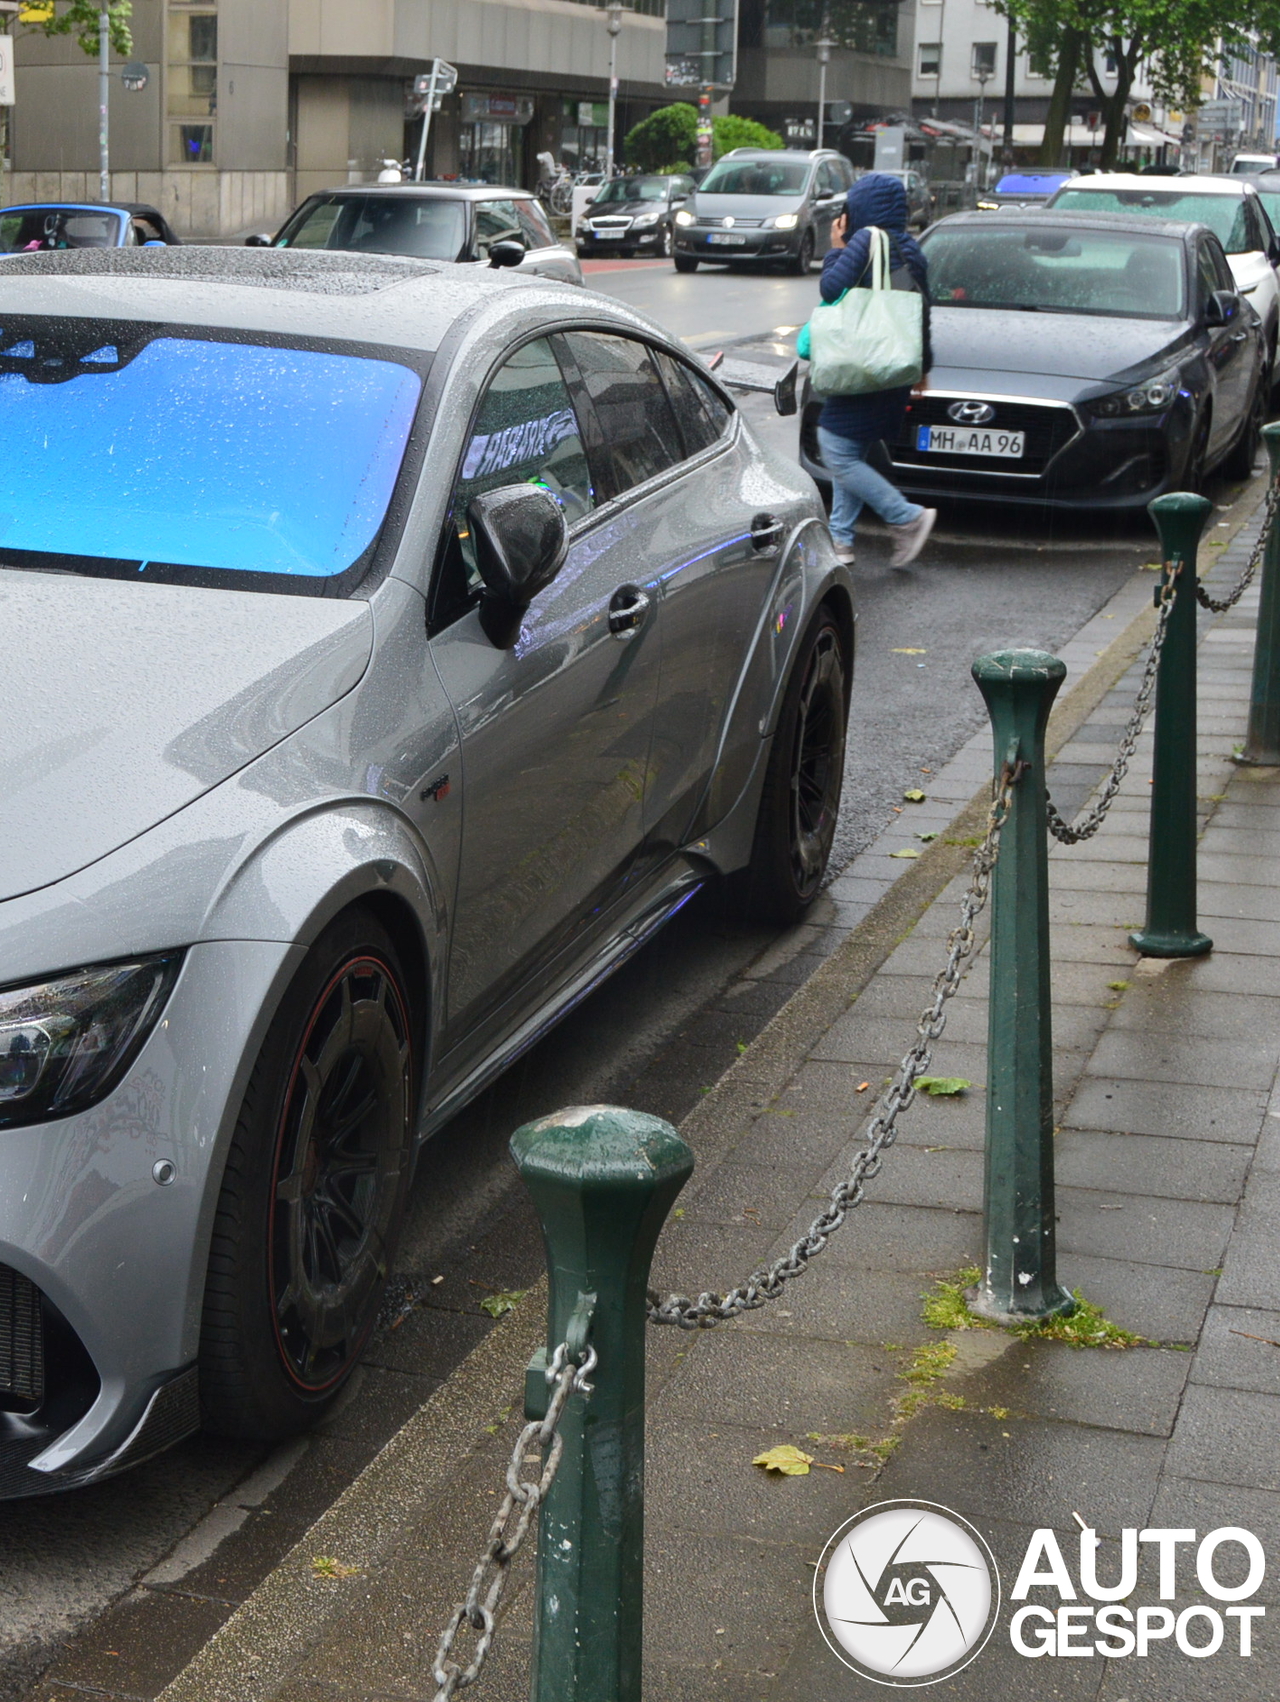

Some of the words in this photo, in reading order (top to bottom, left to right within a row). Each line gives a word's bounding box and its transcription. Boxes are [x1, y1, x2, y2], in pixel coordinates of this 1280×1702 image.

[929, 430, 955, 450] MH
[967, 433, 992, 452] AA
[997, 435, 1021, 454] 96
